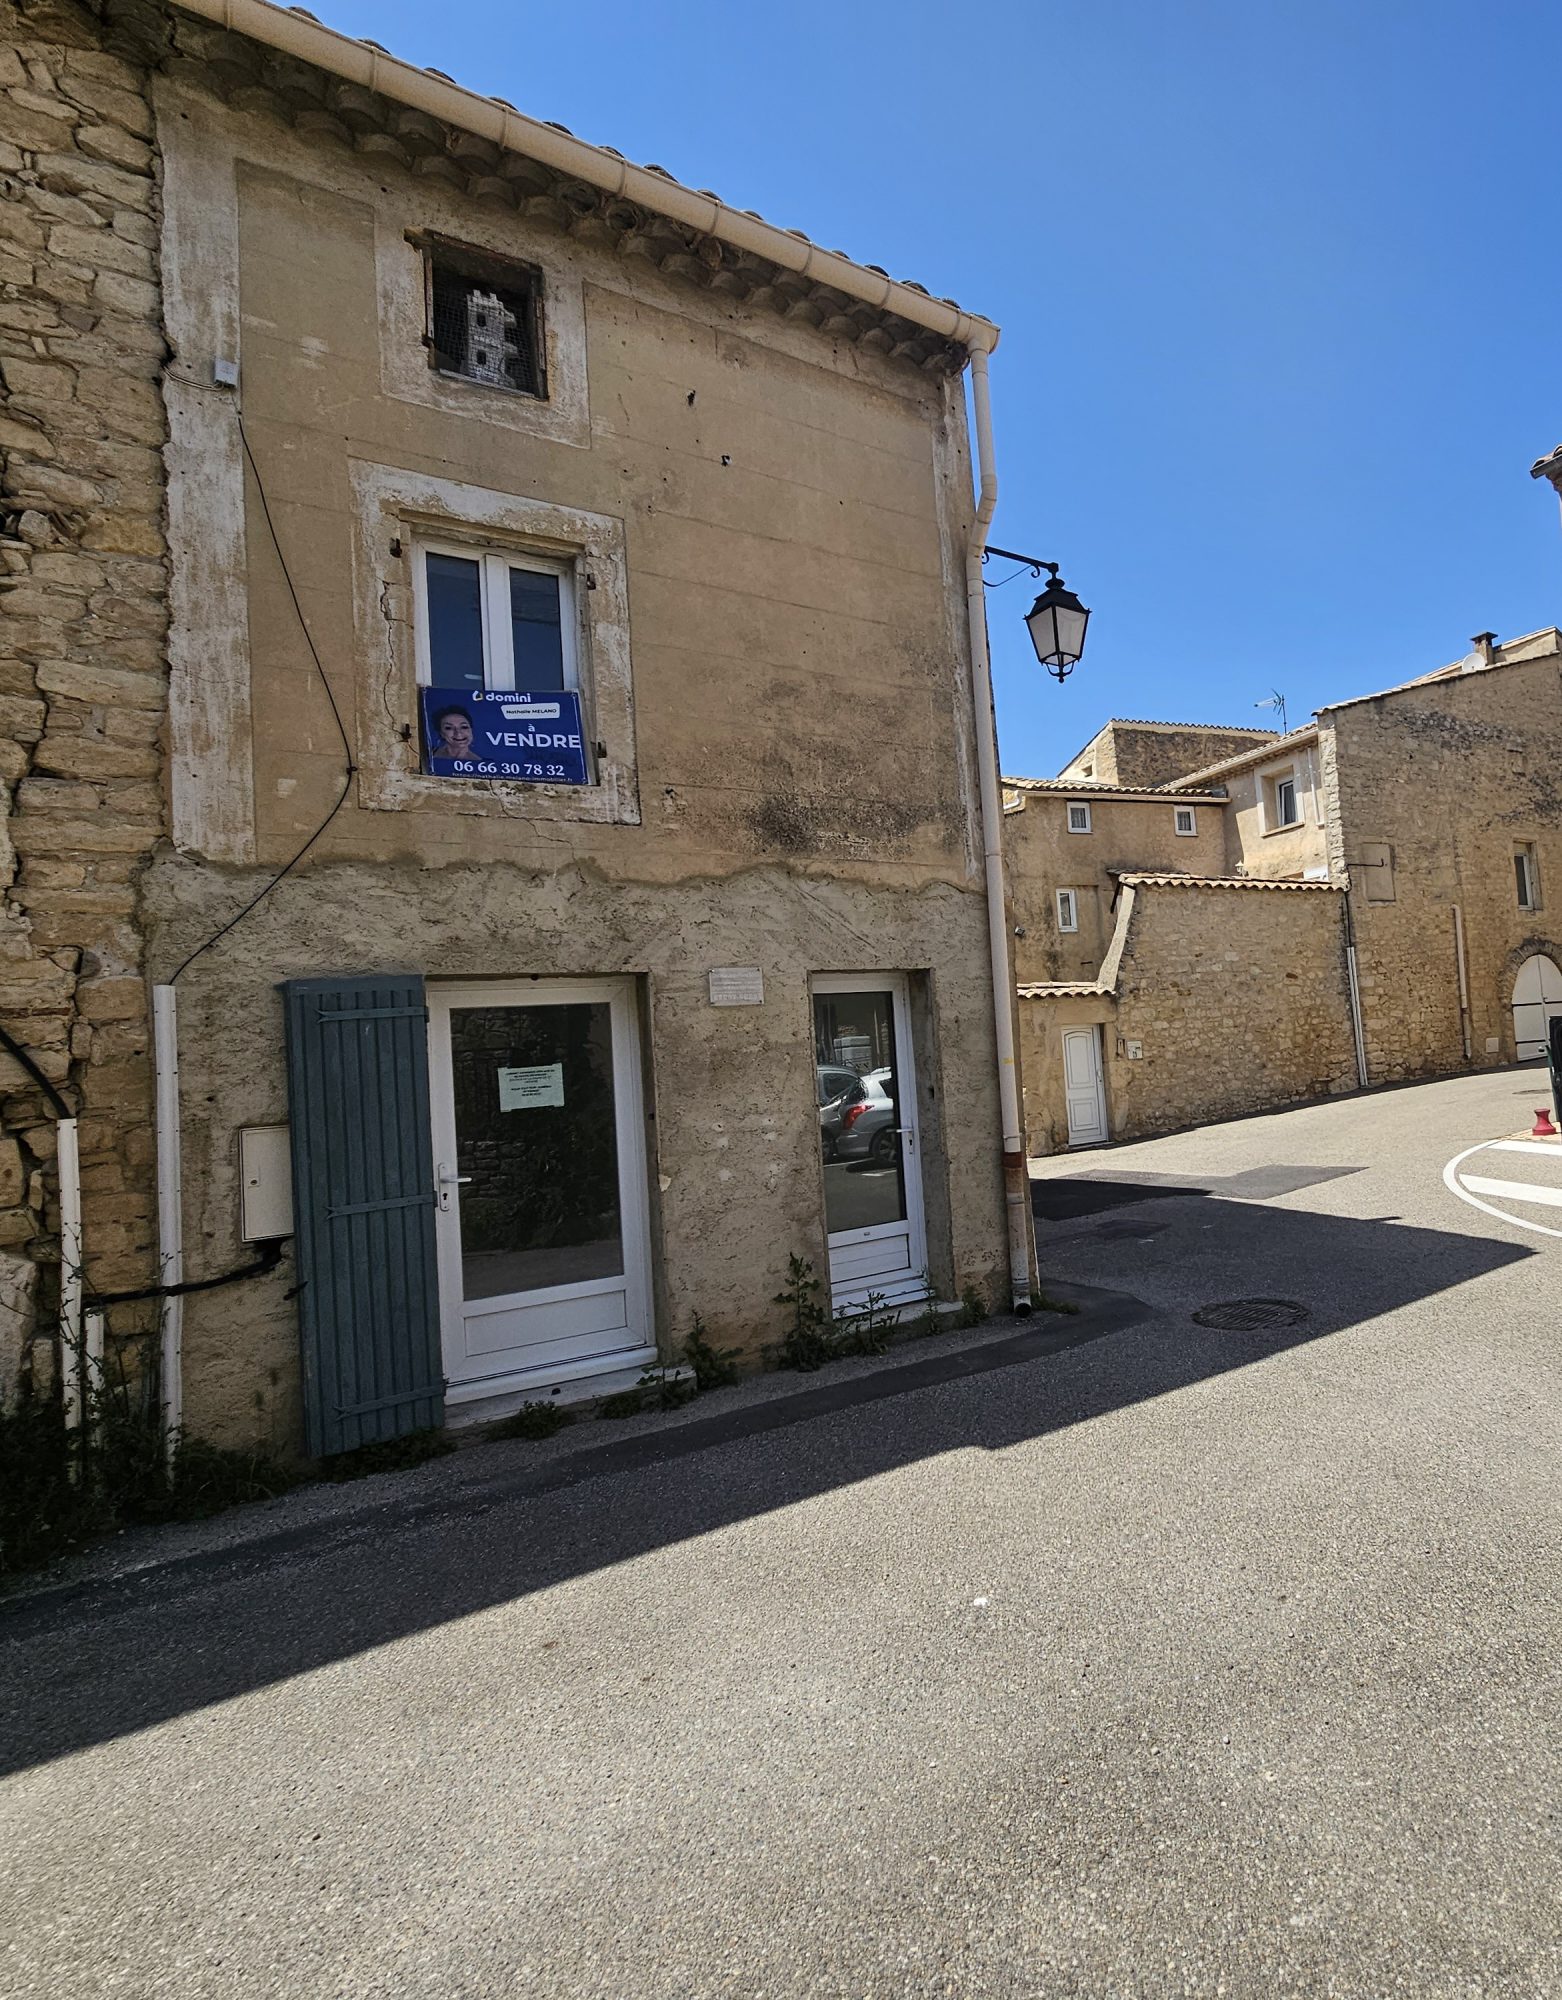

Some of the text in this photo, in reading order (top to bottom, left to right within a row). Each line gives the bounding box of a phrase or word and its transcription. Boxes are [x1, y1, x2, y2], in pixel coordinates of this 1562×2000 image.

[485, 692, 531, 703] domini
[528, 724, 535, 732] à
[485, 731, 581, 748] VENDRE
[453, 760, 565, 777] 06 66 30 78 32
